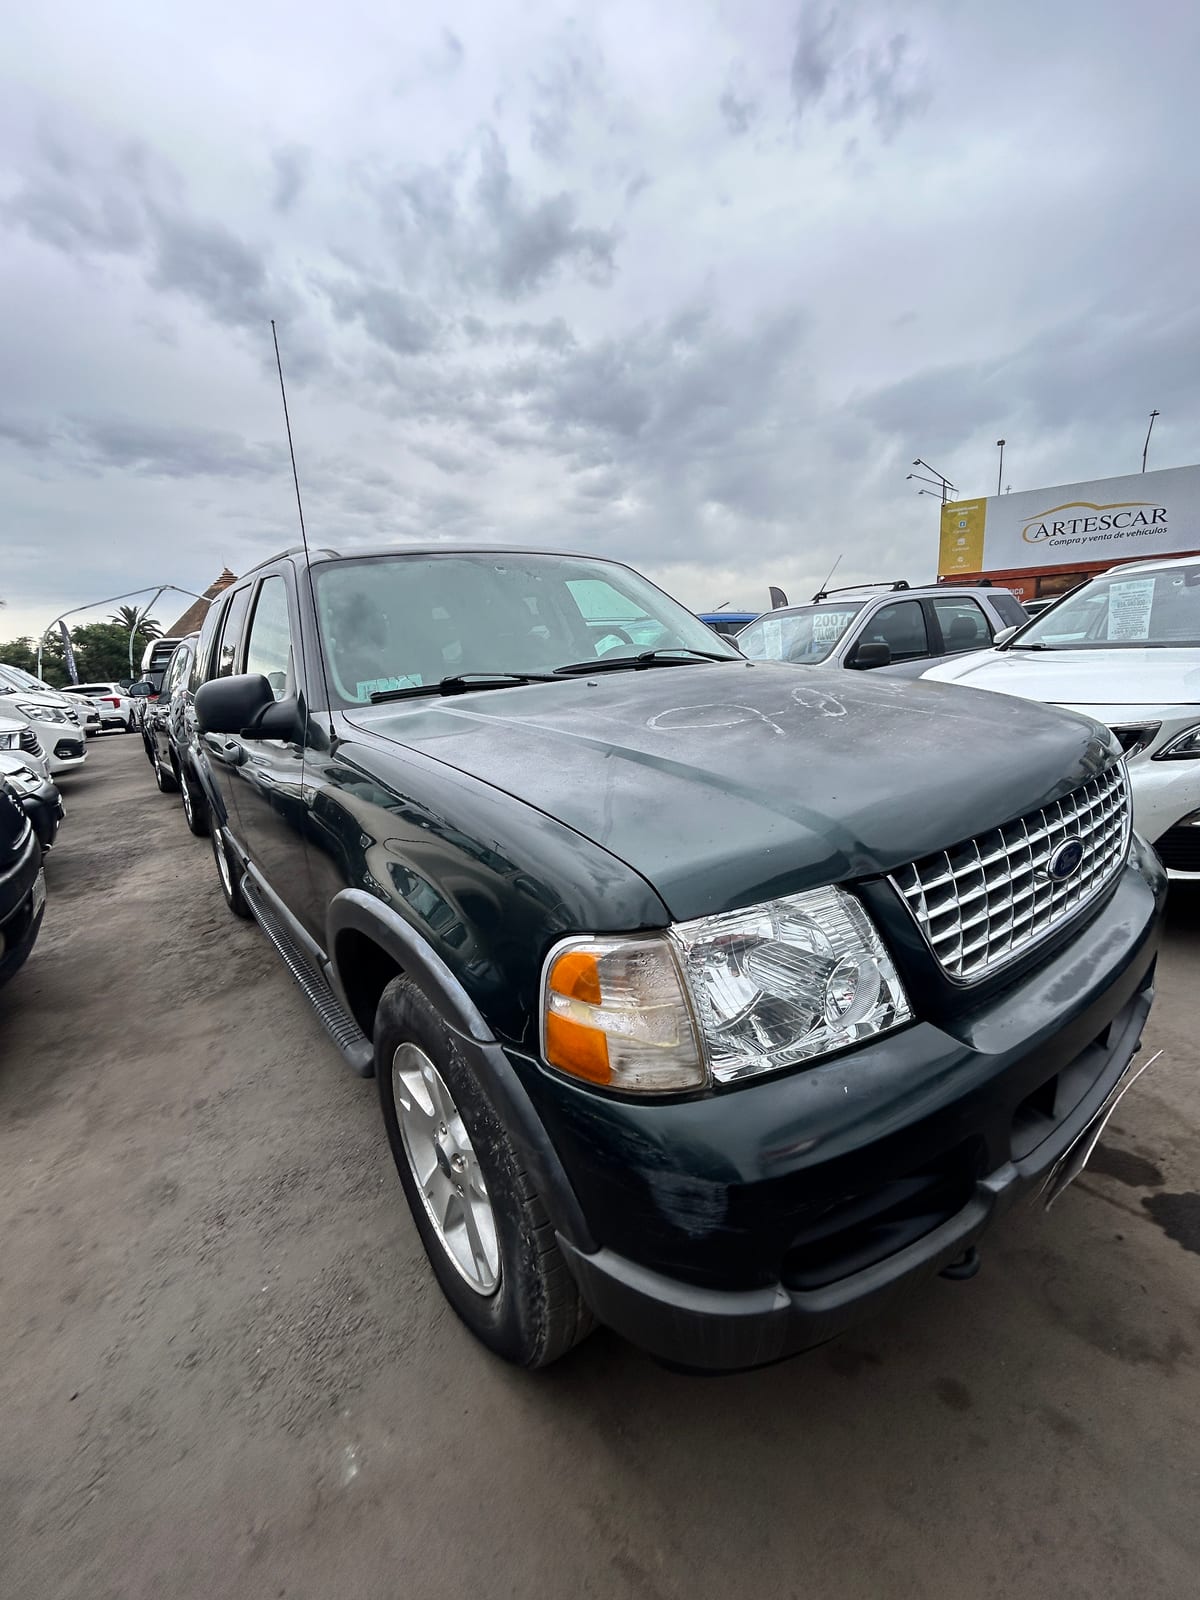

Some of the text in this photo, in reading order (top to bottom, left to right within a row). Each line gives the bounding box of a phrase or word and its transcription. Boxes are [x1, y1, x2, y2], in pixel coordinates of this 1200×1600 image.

[1048, 526, 1168, 546] Compra y venta de vehículos
[815, 614, 847, 627] 2007
